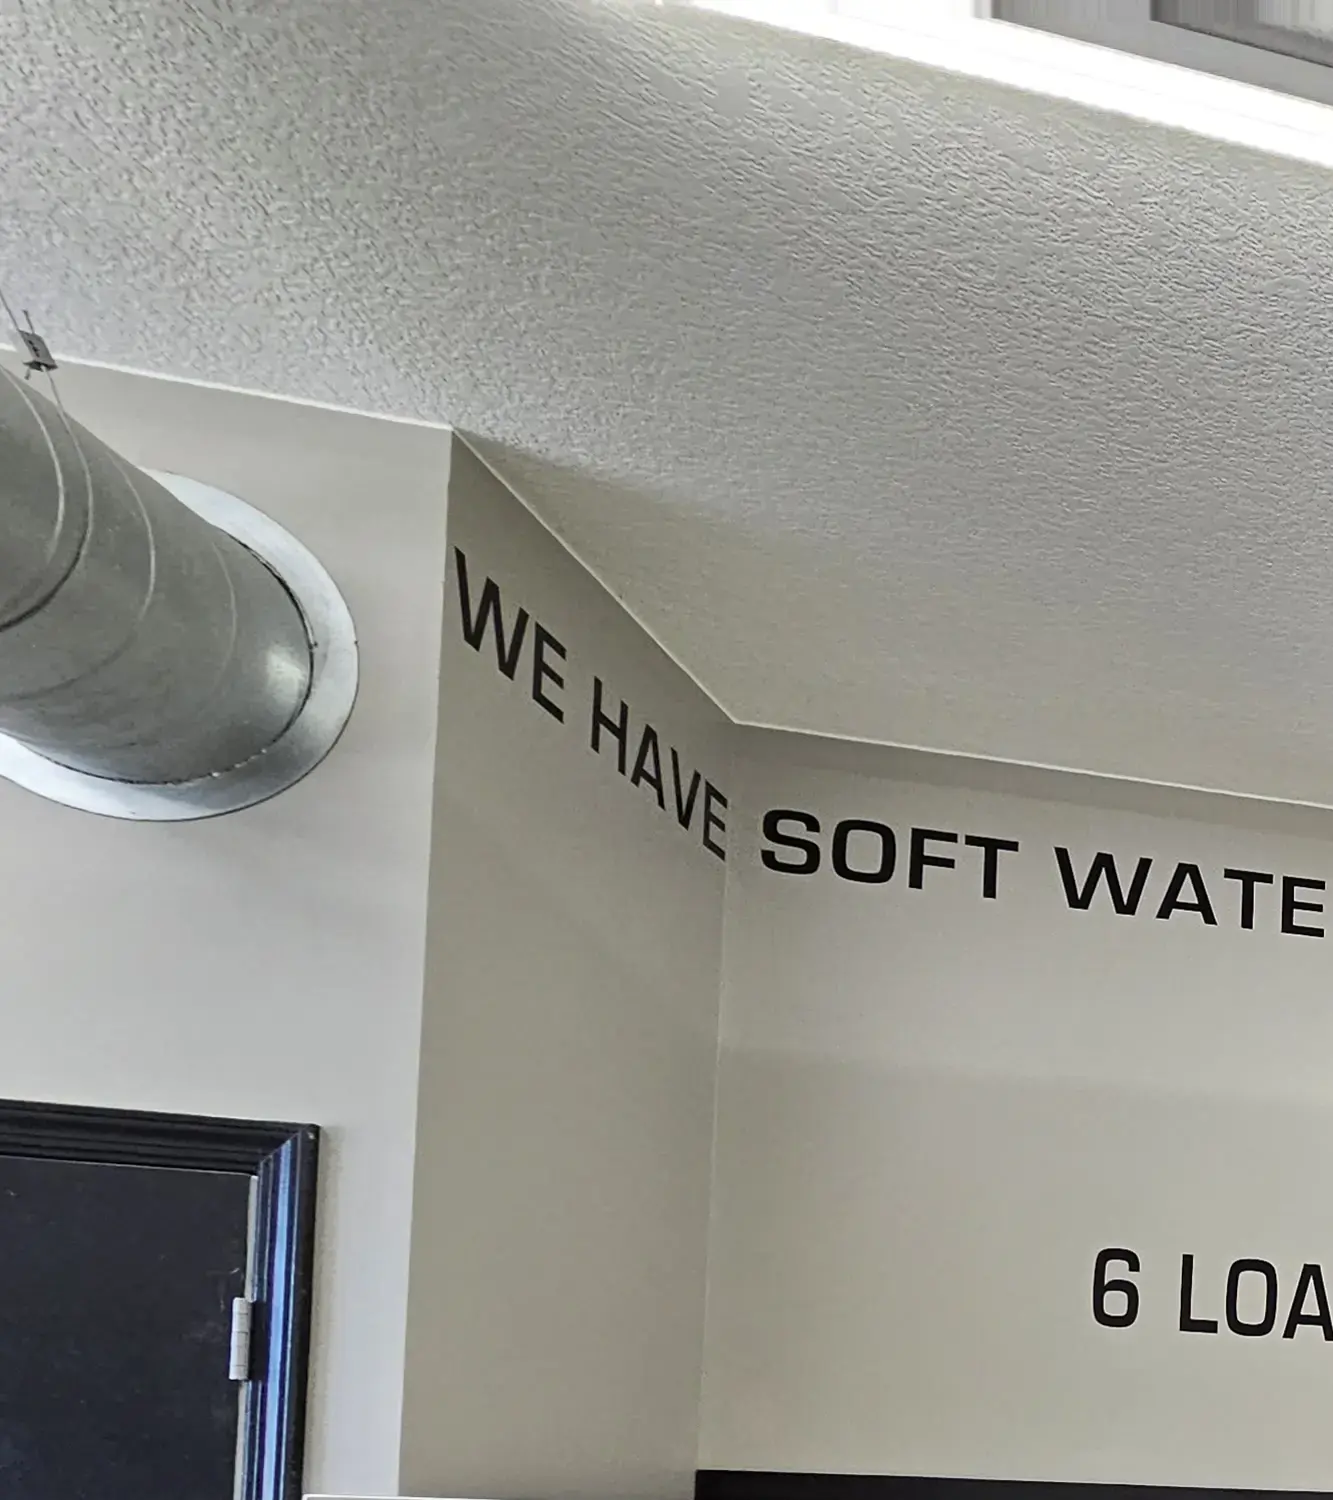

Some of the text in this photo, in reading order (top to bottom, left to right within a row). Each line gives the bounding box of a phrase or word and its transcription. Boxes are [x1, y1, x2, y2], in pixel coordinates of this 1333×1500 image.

[453, 545, 728, 862] WE HAVE
[760, 809, 1020, 900] SOFT
[1092, 1248, 1140, 1328] 6
